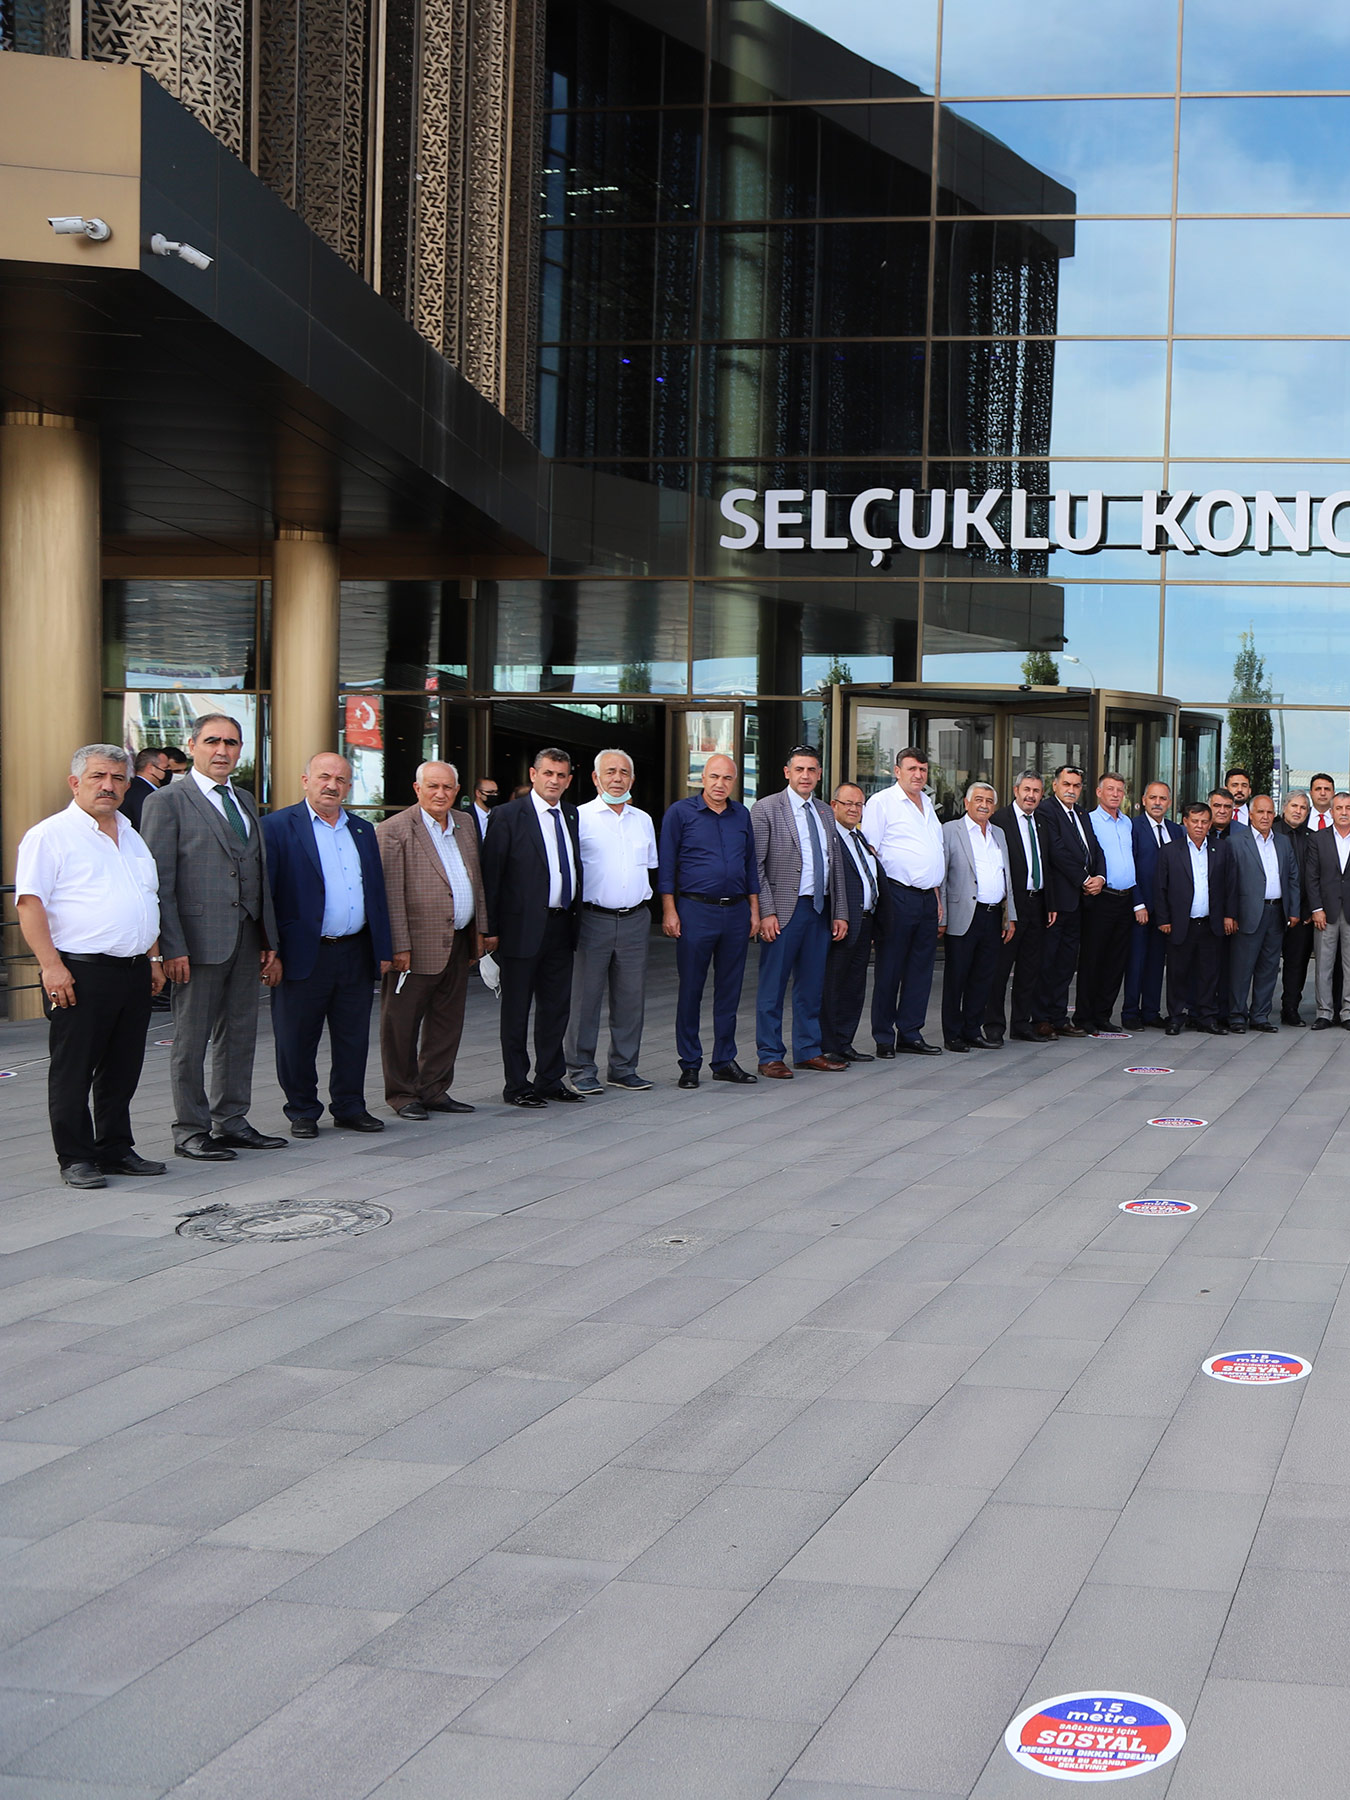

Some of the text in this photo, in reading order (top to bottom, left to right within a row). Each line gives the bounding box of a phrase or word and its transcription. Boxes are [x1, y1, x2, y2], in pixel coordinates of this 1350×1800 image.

[720, 488, 1103, 568] SELÇUKLU
[1222, 1365, 1290, 1374] SOSYAL
[1093, 1701, 1124, 1713] 1.5
[1066, 1711, 1137, 1725] metre
[1037, 1730, 1147, 1752] SOSYAL
[1019, 1745, 1075, 1756] MESAFEYE
